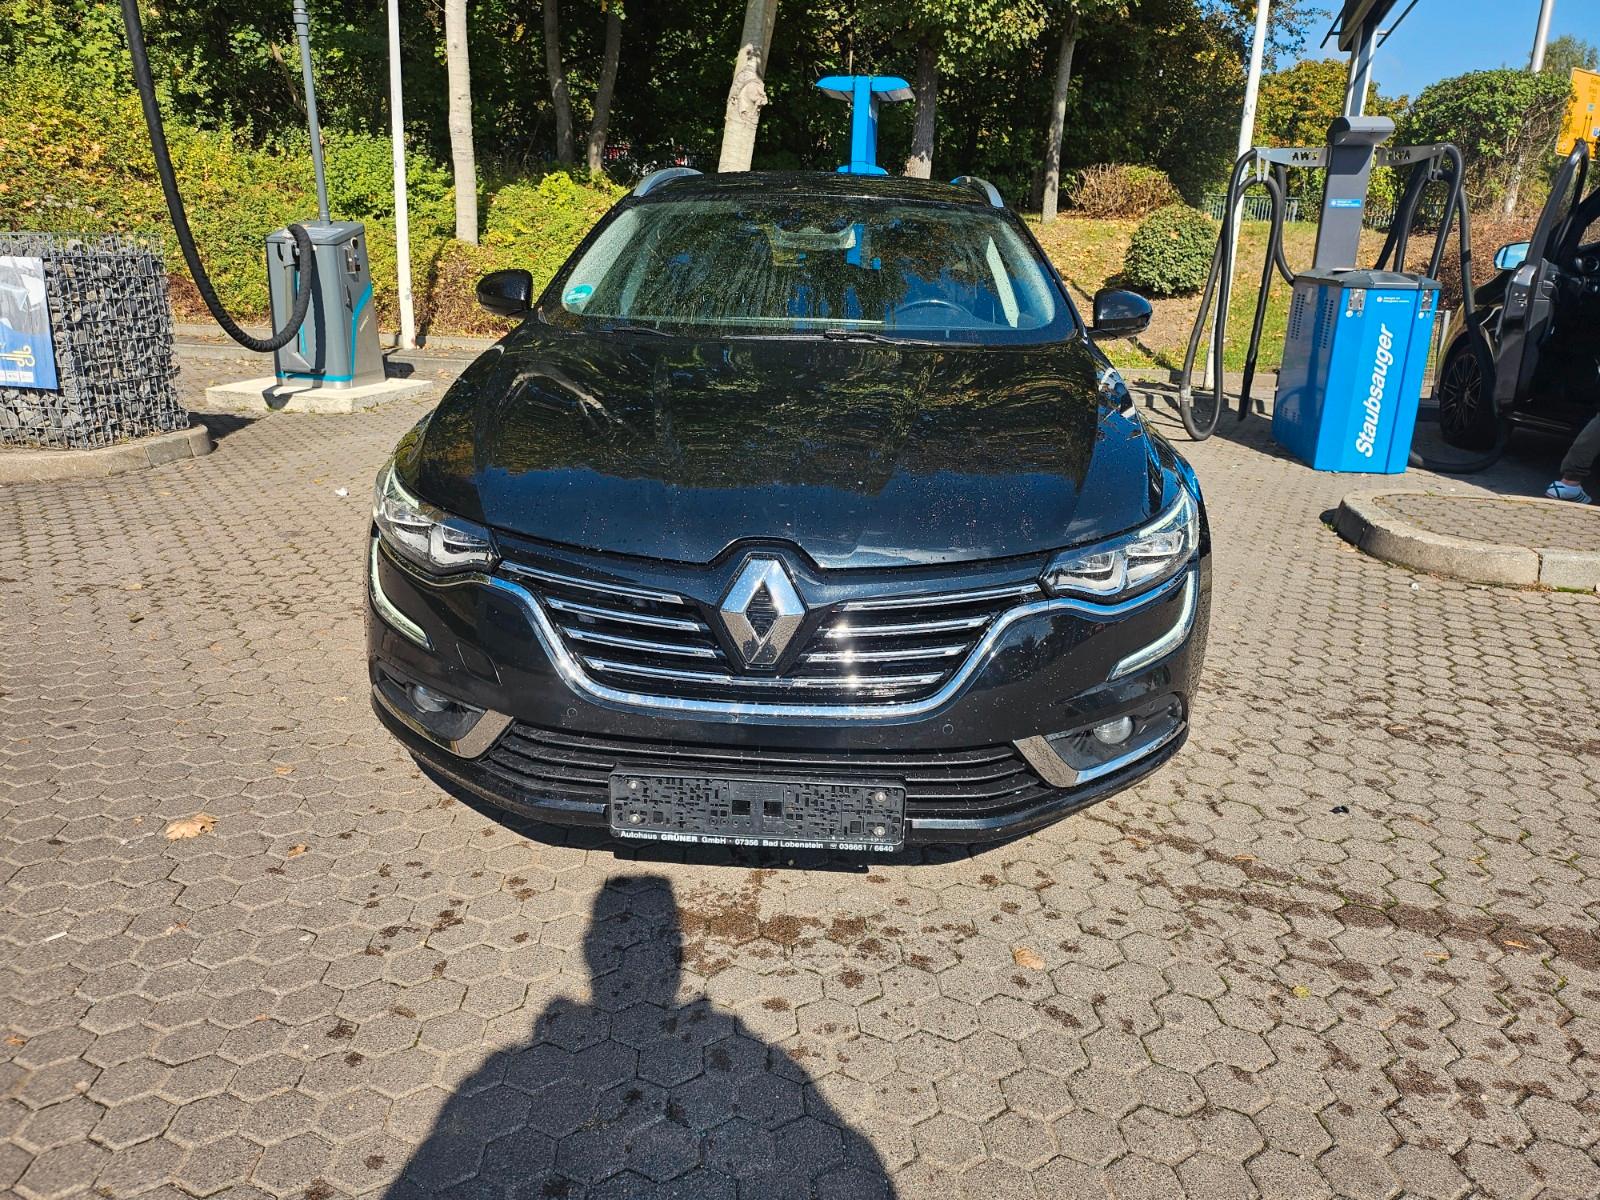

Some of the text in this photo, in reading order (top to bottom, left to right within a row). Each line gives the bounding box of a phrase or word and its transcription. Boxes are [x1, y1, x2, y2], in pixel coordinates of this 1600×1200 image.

[1355, 322, 1394, 458] Staubsauger
[620, 831, 657, 840] Autohaus
[661, 833, 698, 843] GRÜNER
[701, 836, 727, 845] GmbH
[762, 839, 779, 848] Bad
[780, 840, 824, 849] Lobenstein
